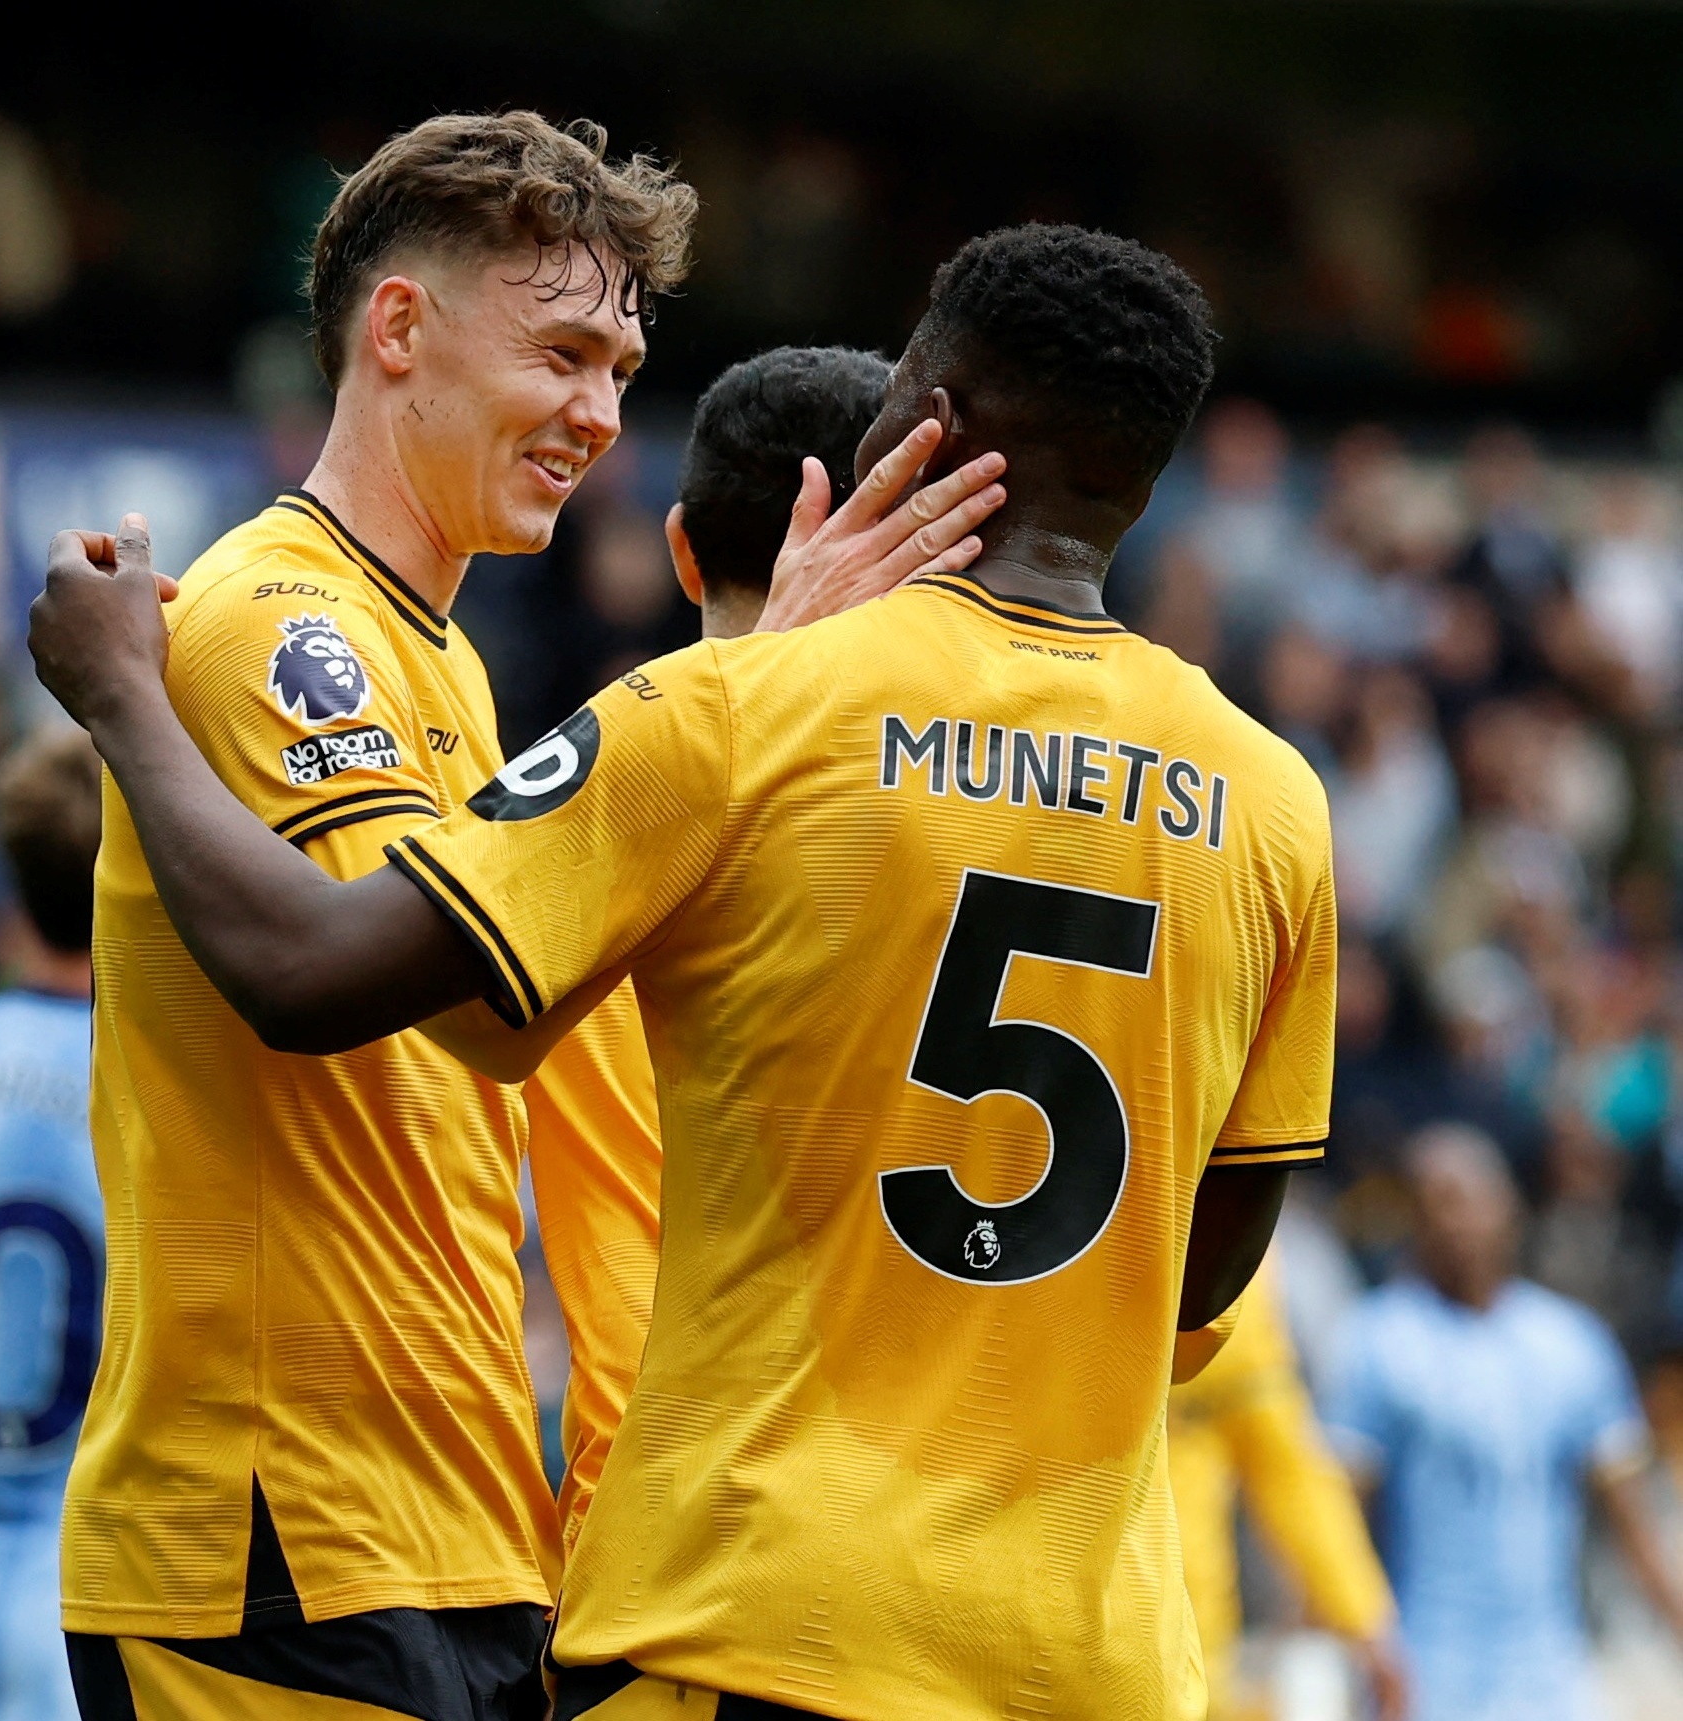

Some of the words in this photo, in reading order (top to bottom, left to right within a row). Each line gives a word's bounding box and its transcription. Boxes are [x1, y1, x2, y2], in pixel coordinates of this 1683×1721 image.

[251, 581, 340, 602] SUDU
[1009, 640, 1047, 655] ONE
[1048, 648, 1103, 661] PACK
[281, 743, 319, 771] No
[319, 729, 387, 754] room
[426, 727, 459, 755] DU
[287, 760, 323, 785] for
[325, 748, 402, 775] racism
[879, 713, 1228, 851] MUNETSI
[877, 867, 1161, 1286] 5
